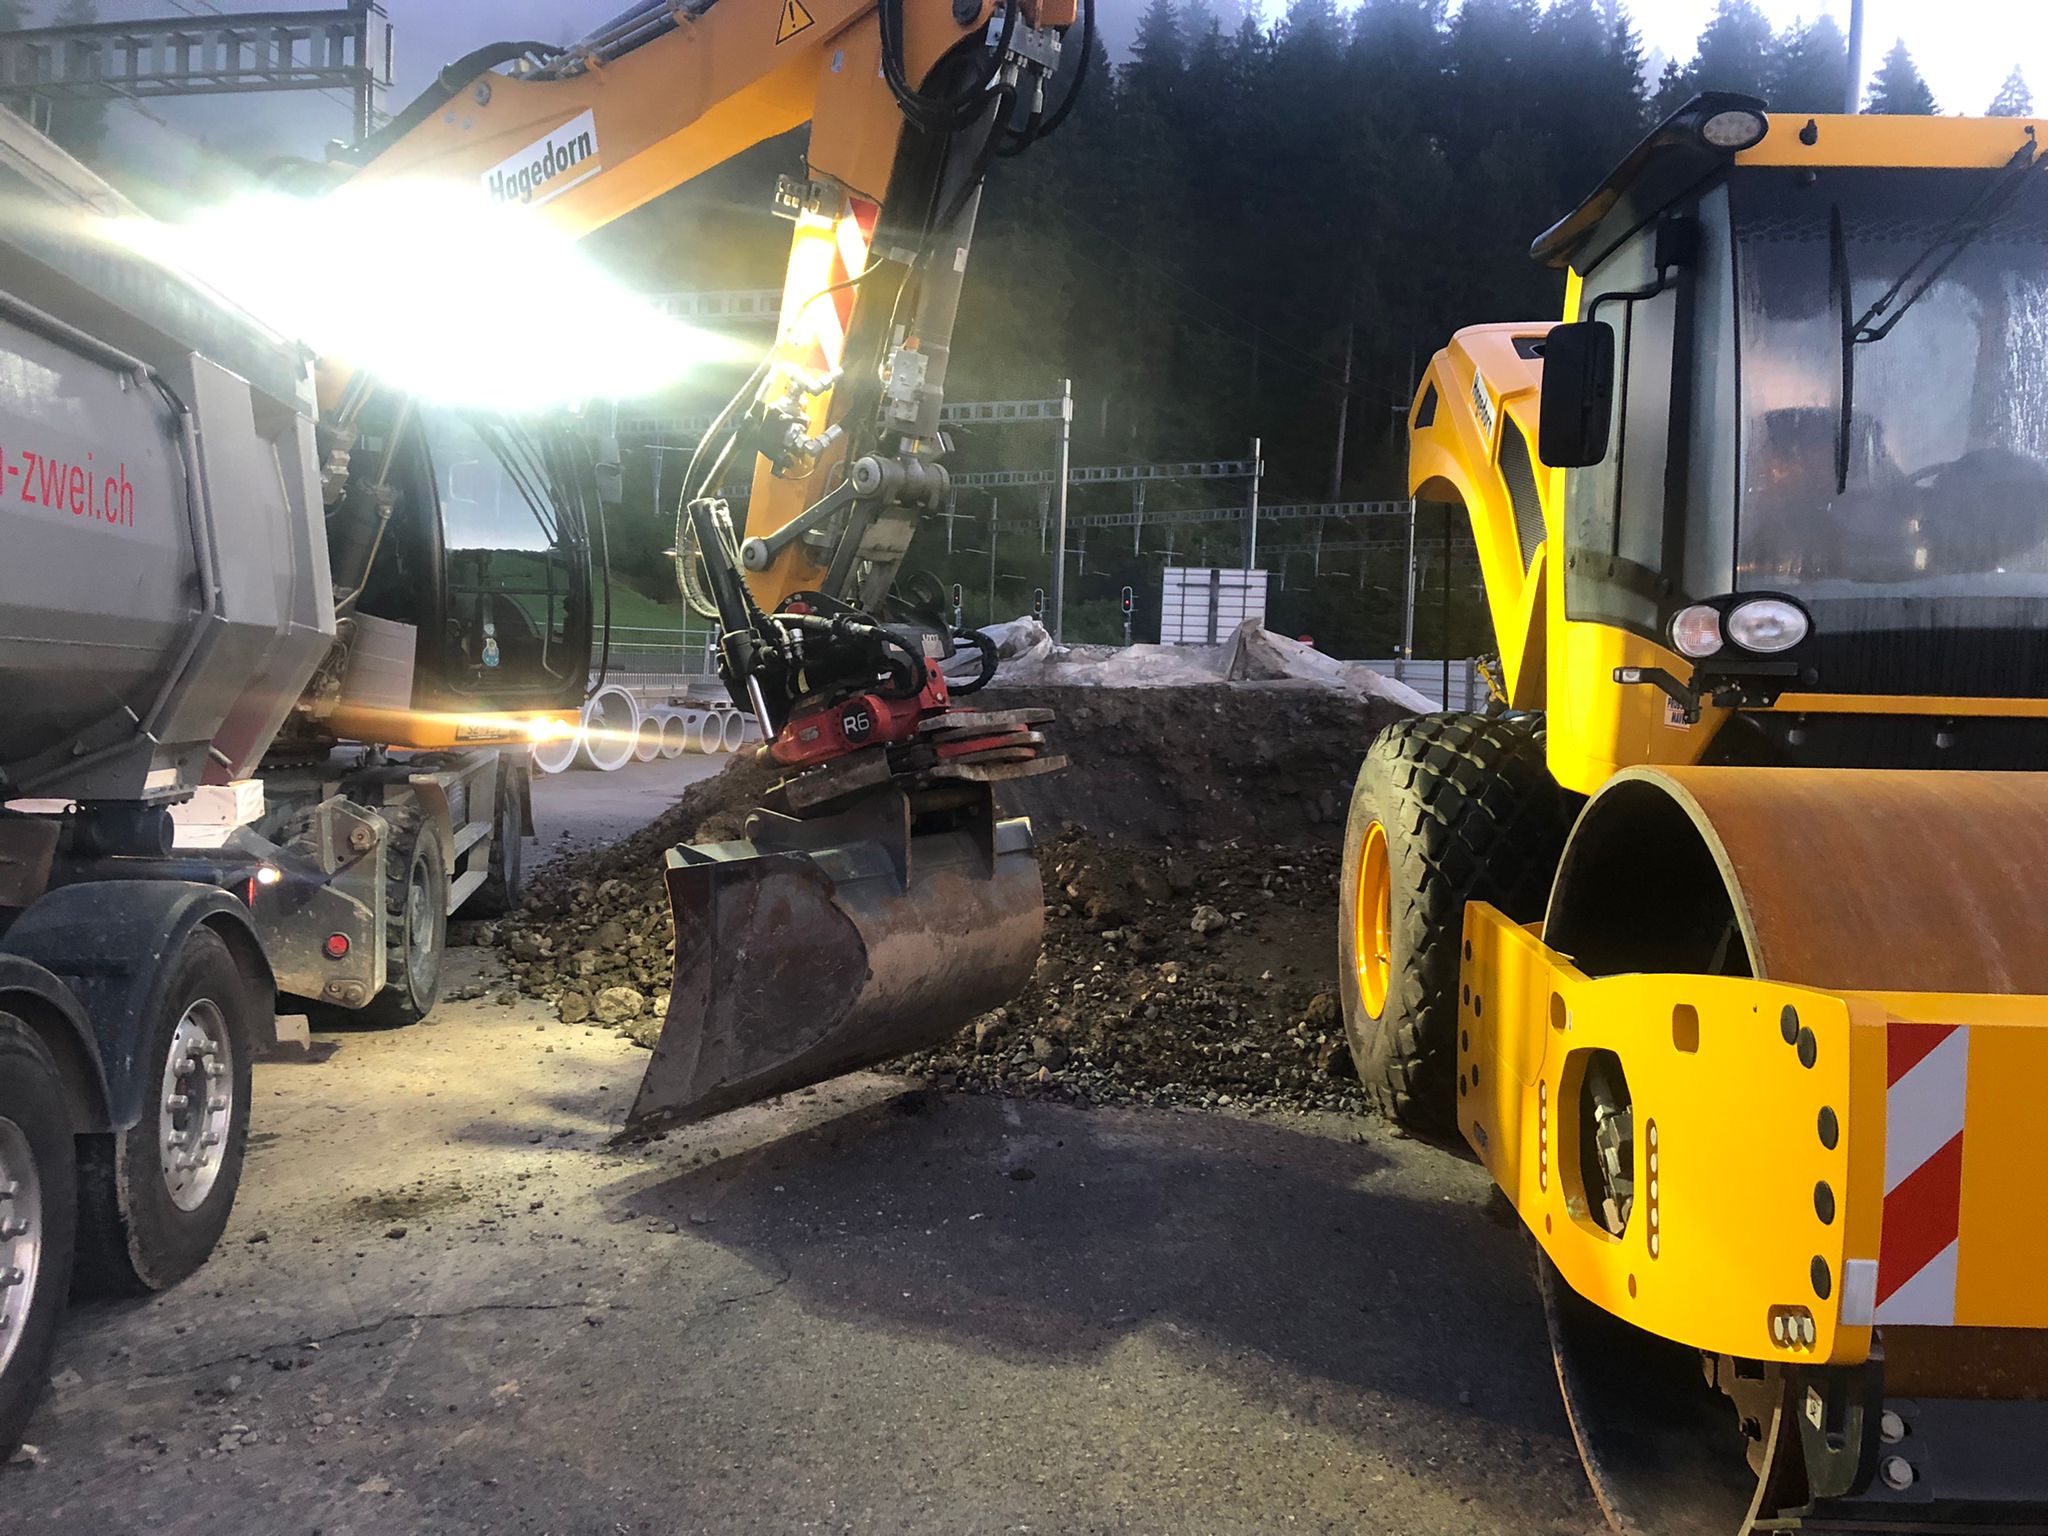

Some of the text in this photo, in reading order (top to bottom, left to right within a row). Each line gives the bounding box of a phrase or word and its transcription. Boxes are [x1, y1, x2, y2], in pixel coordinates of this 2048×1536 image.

[489, 130, 592, 204] Hagedorn
[0, 447, 134, 528] -zwei.ch
[843, 712, 870, 735] R6
